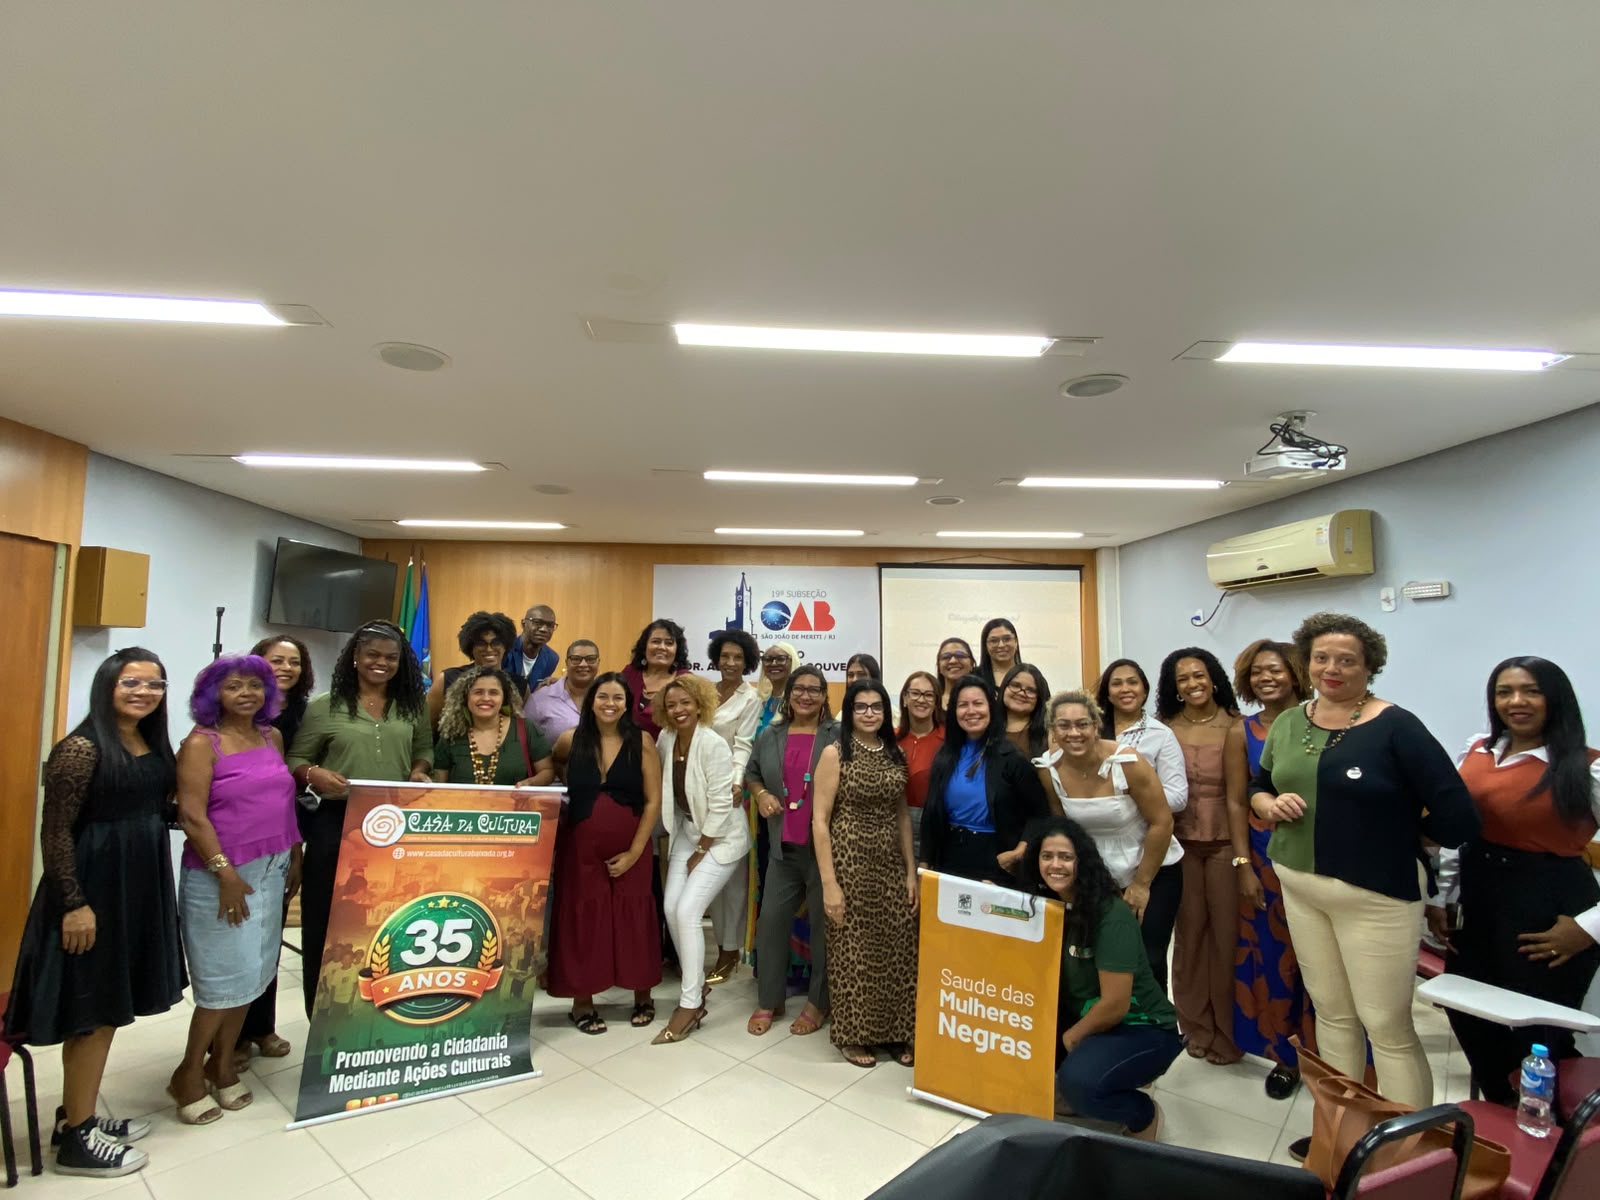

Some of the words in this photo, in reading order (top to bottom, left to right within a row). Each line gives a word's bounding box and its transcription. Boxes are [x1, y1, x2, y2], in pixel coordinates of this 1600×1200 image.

[786, 589, 827, 599] SUBSEÇÃO
[760, 600, 836, 631] OAB
[808, 663, 847, 671] OUVE
[408, 812, 453, 832] CASA
[456, 819, 473, 832] DA
[478, 814, 537, 834] CULTURA
[400, 918, 473, 966] 35
[398, 971, 467, 992] ANOS
[940, 968, 996, 998] Saúde
[1001, 984, 1034, 1007] das
[940, 988, 1033, 1031] Mulheres
[336, 1042, 426, 1070] Promovendo
[431, 1044, 440, 1057] a
[444, 1032, 508, 1054] Cidadania
[938, 1012, 1032, 1060] Negras
[329, 1066, 399, 1094] Mediante
[403, 1060, 447, 1087] Ações
[450, 1053, 511, 1074] Culturais
